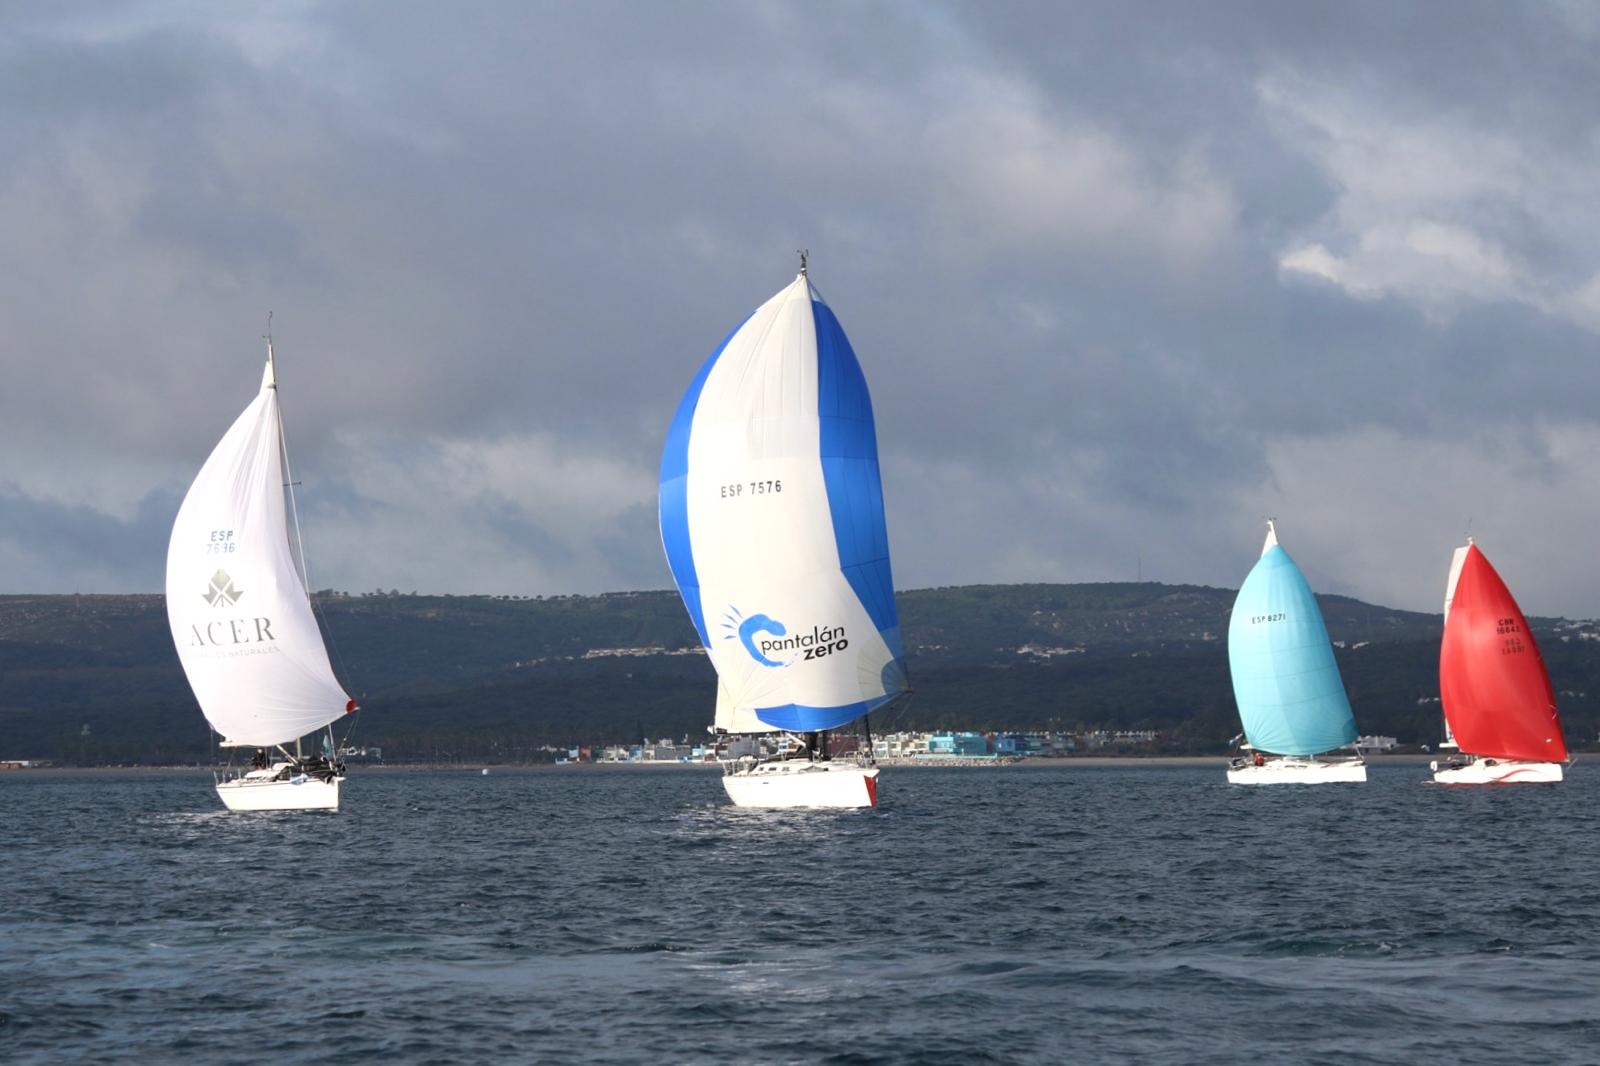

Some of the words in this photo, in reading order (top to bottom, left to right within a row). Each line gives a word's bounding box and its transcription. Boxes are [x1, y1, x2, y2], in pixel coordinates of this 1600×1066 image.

[721, 483, 743, 498] ESP
[750, 480, 782, 495] 7576
[210, 530, 233, 542] ESP
[1252, 615, 1266, 624] ESP
[191, 616, 276, 647] ACER
[761, 625, 845, 655] pantalán
[803, 639, 849, 661] zero
